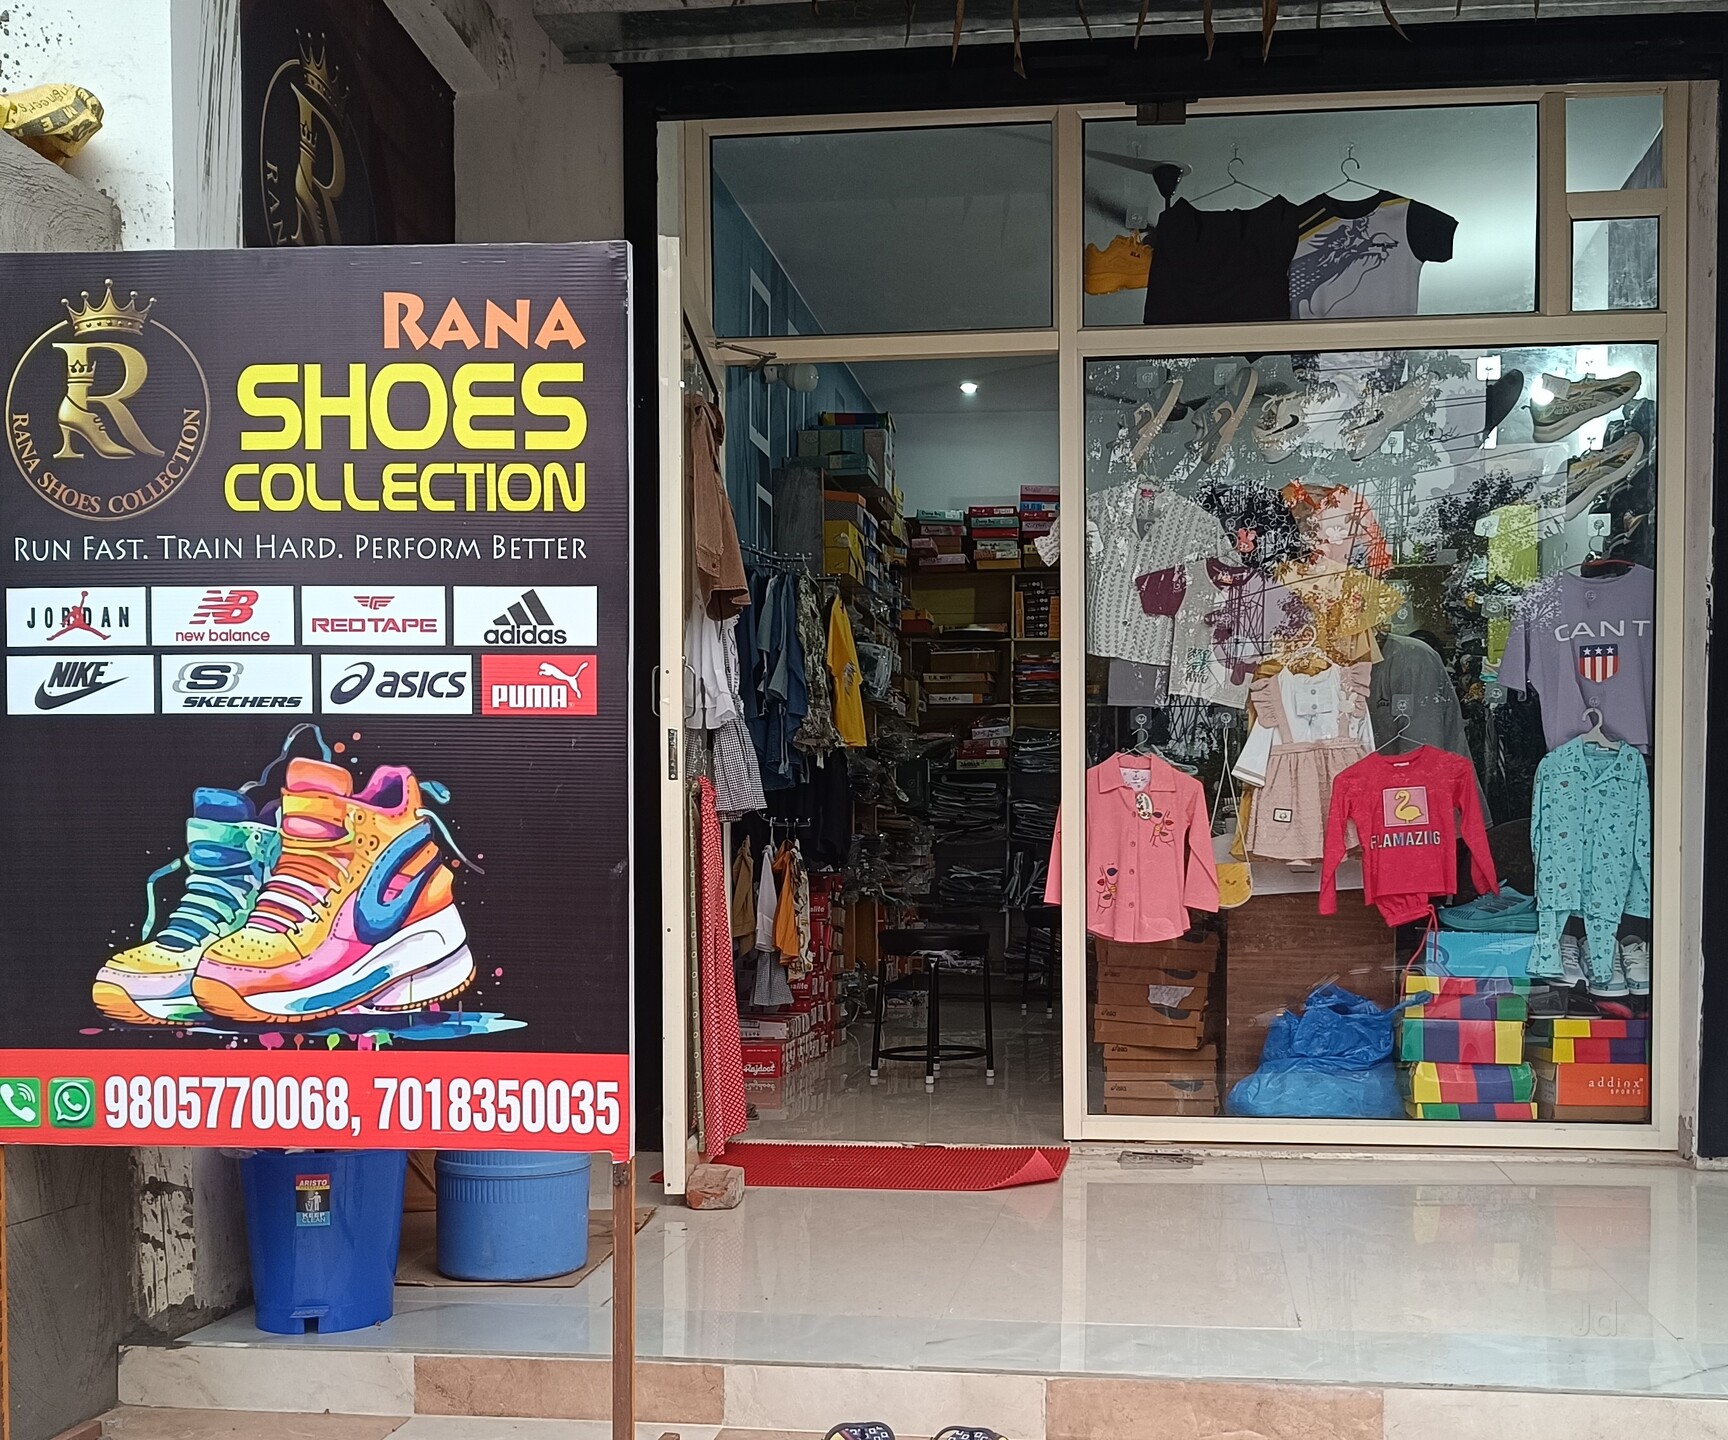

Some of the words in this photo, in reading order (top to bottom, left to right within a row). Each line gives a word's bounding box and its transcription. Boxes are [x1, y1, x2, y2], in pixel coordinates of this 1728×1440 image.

[266, 160, 288, 246] RAN
[383, 291, 587, 351] RANA
[236, 362, 588, 451] SHOES
[13, 412, 41, 474] RANA
[37, 471, 101, 514] SHOES
[108, 407, 201, 514] COLLECTION
[224, 462, 586, 513] COLLECTION
[27, 606, 130, 629] JORDAN
[175, 630, 206, 642] new
[208, 629, 271, 642] balance
[483, 624, 568, 645] adidas
[48, 661, 109, 688] NIKE
[375, 671, 467, 698] asics
[182, 696, 303, 708] SKECHERS
[491, 684, 569, 708] PUMA
[104, 1075, 361, 1137] 9805770068,
[373, 1077, 620, 1135] 7018350035
